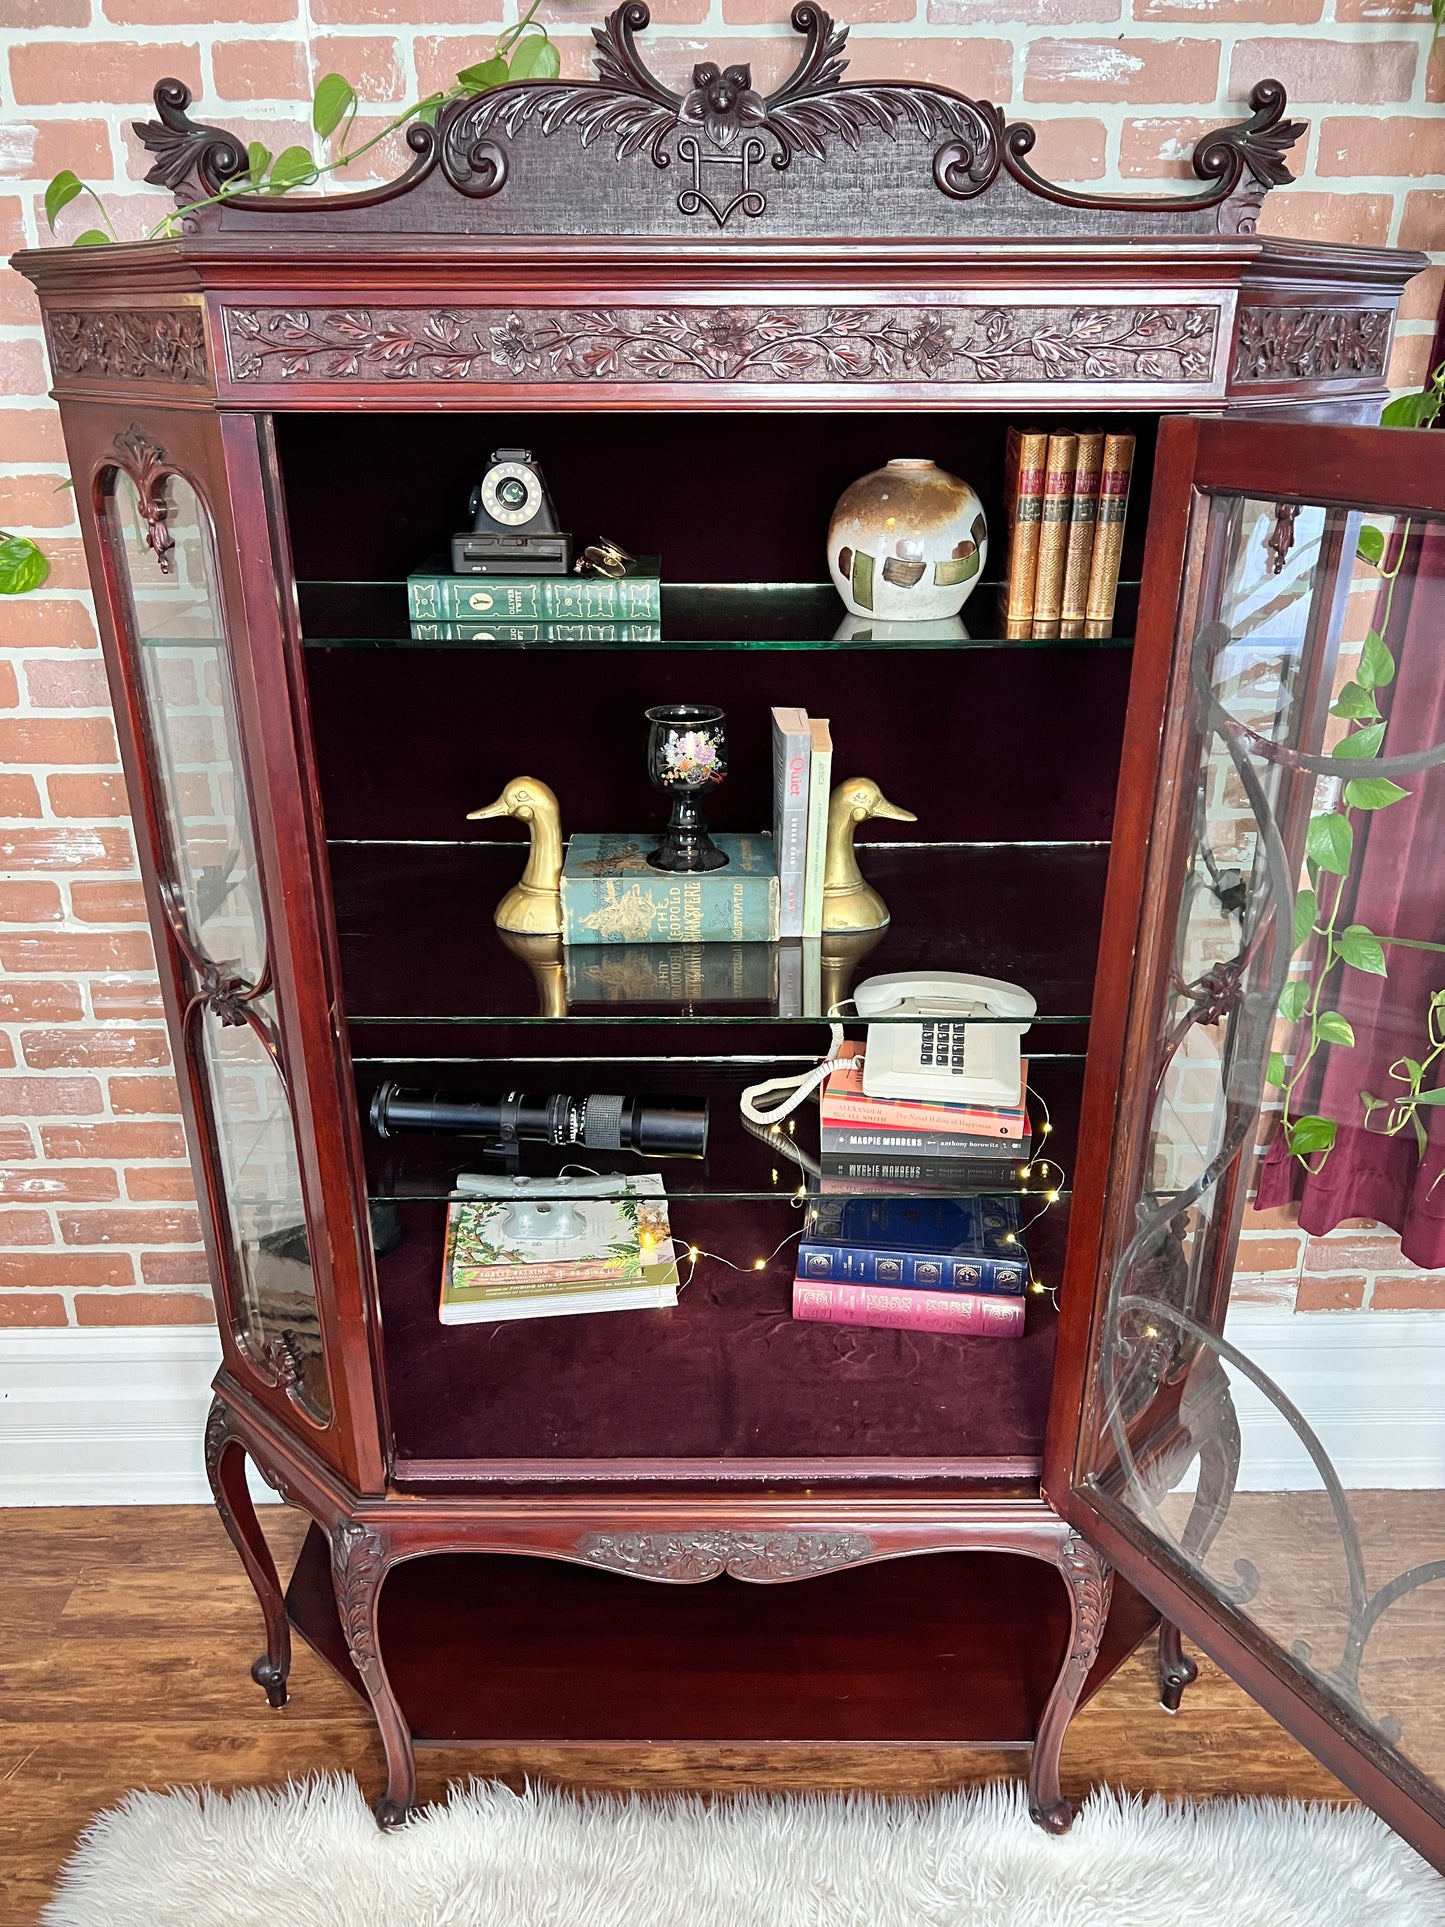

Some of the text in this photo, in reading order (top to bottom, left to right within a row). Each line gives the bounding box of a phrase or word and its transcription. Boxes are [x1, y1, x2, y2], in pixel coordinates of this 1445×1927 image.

[789, 755, 805, 797] Quiet
[789, 846, 797, 865] CAIN
[656, 897, 669, 932] THE
[667, 886, 684, 941] LEOPOLD
[682, 881, 705, 942] SHAKSPERE
[731, 883, 744, 942] ILLUSTRATED
[839, 1104, 883, 1115] ALEXANDER
[862, 1114, 887, 1123] SMITH
[908, 1113, 928, 1122] Novel
[929, 1115, 949, 1125] Habits
[959, 1119, 992, 1130] Happiness
[849, 1135, 923, 1147] MAGPIE MURDERS
[940, 1140, 999, 1149] anthony horowitz
[480, 1268, 549, 1278] FOREST BATHING
